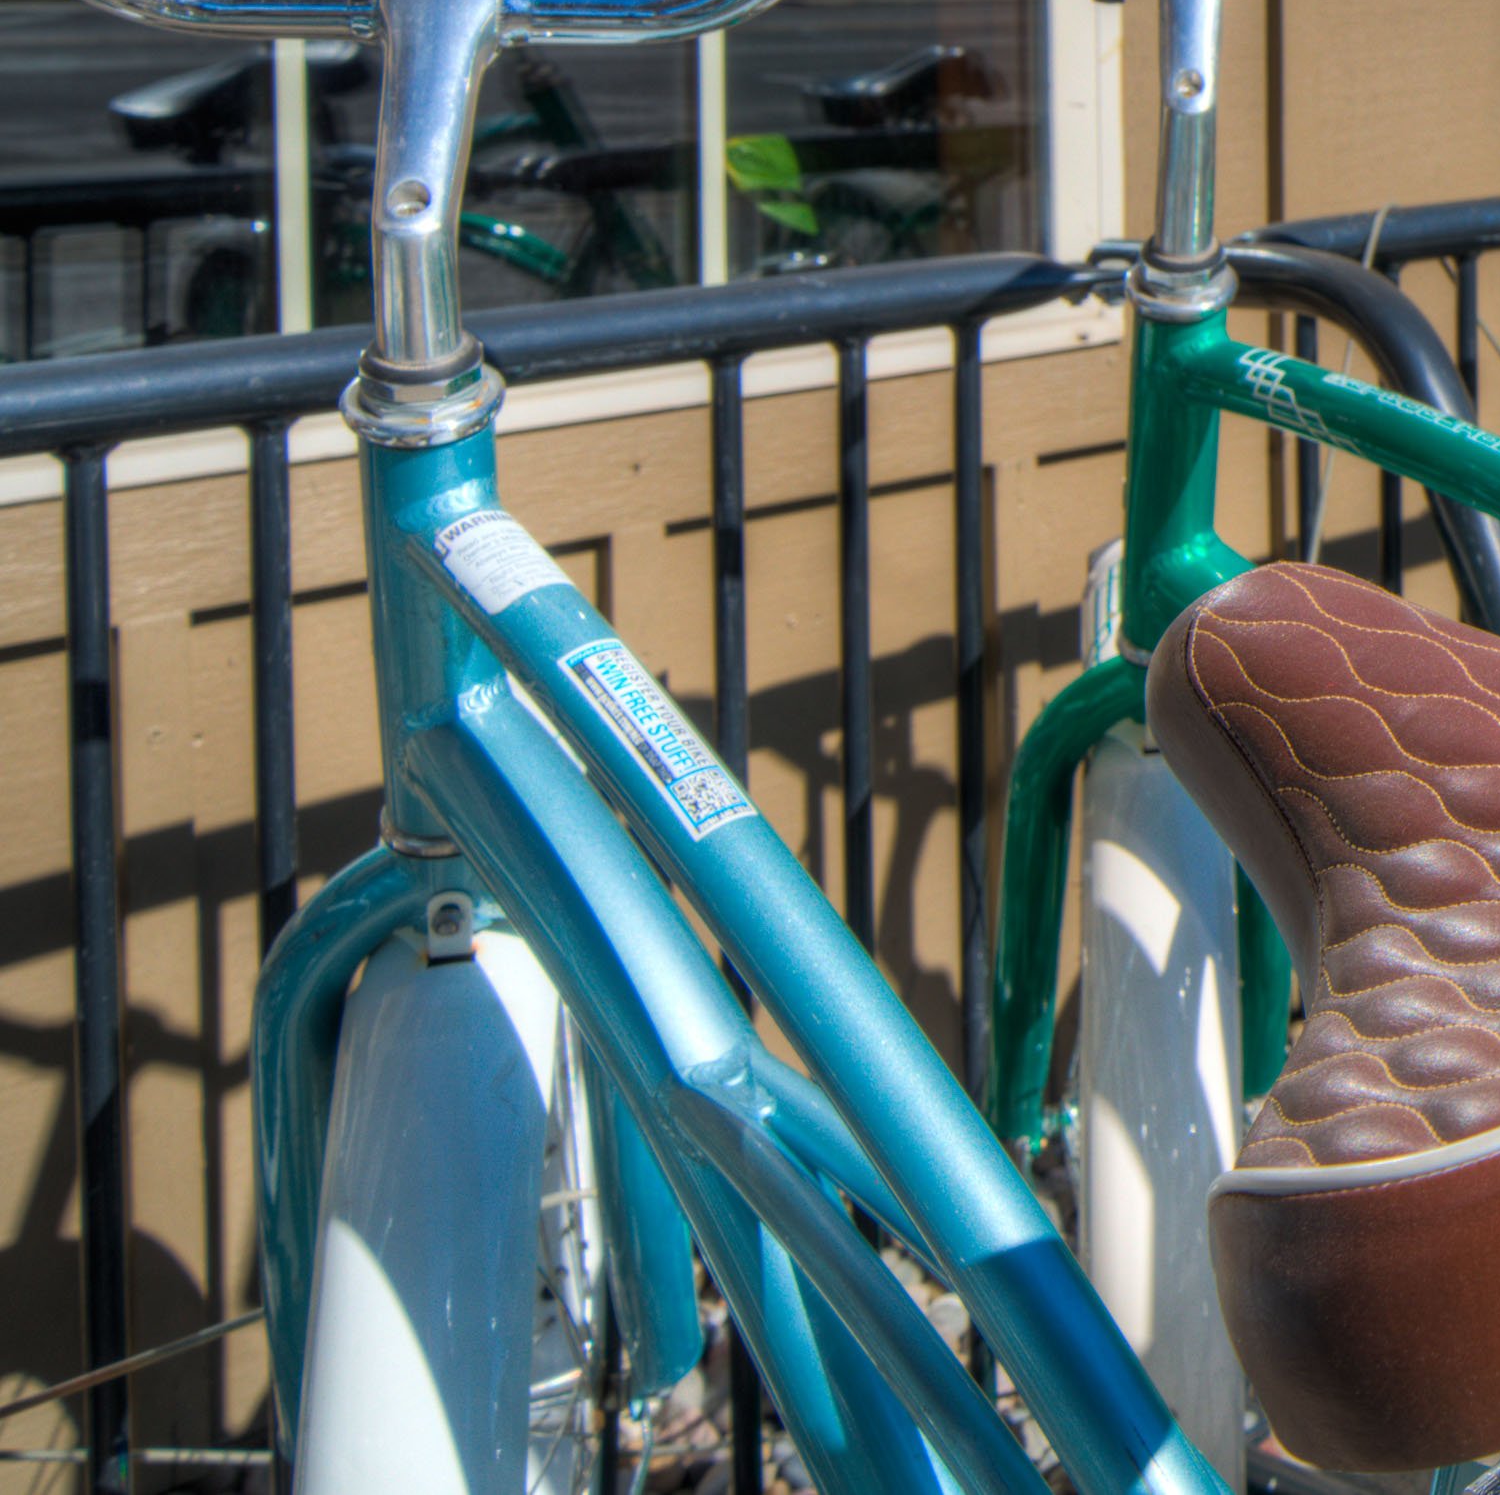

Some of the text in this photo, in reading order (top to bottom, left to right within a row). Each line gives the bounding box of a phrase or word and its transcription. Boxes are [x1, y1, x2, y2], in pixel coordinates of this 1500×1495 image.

[596, 658, 632, 691] WIN
[621, 690, 659, 725] FREE
[648, 722, 698, 774] STUFF!
[609, 649, 660, 702] REGISTER
[657, 705, 687, 737] YOUR
[681, 737, 709, 765] BIKE
